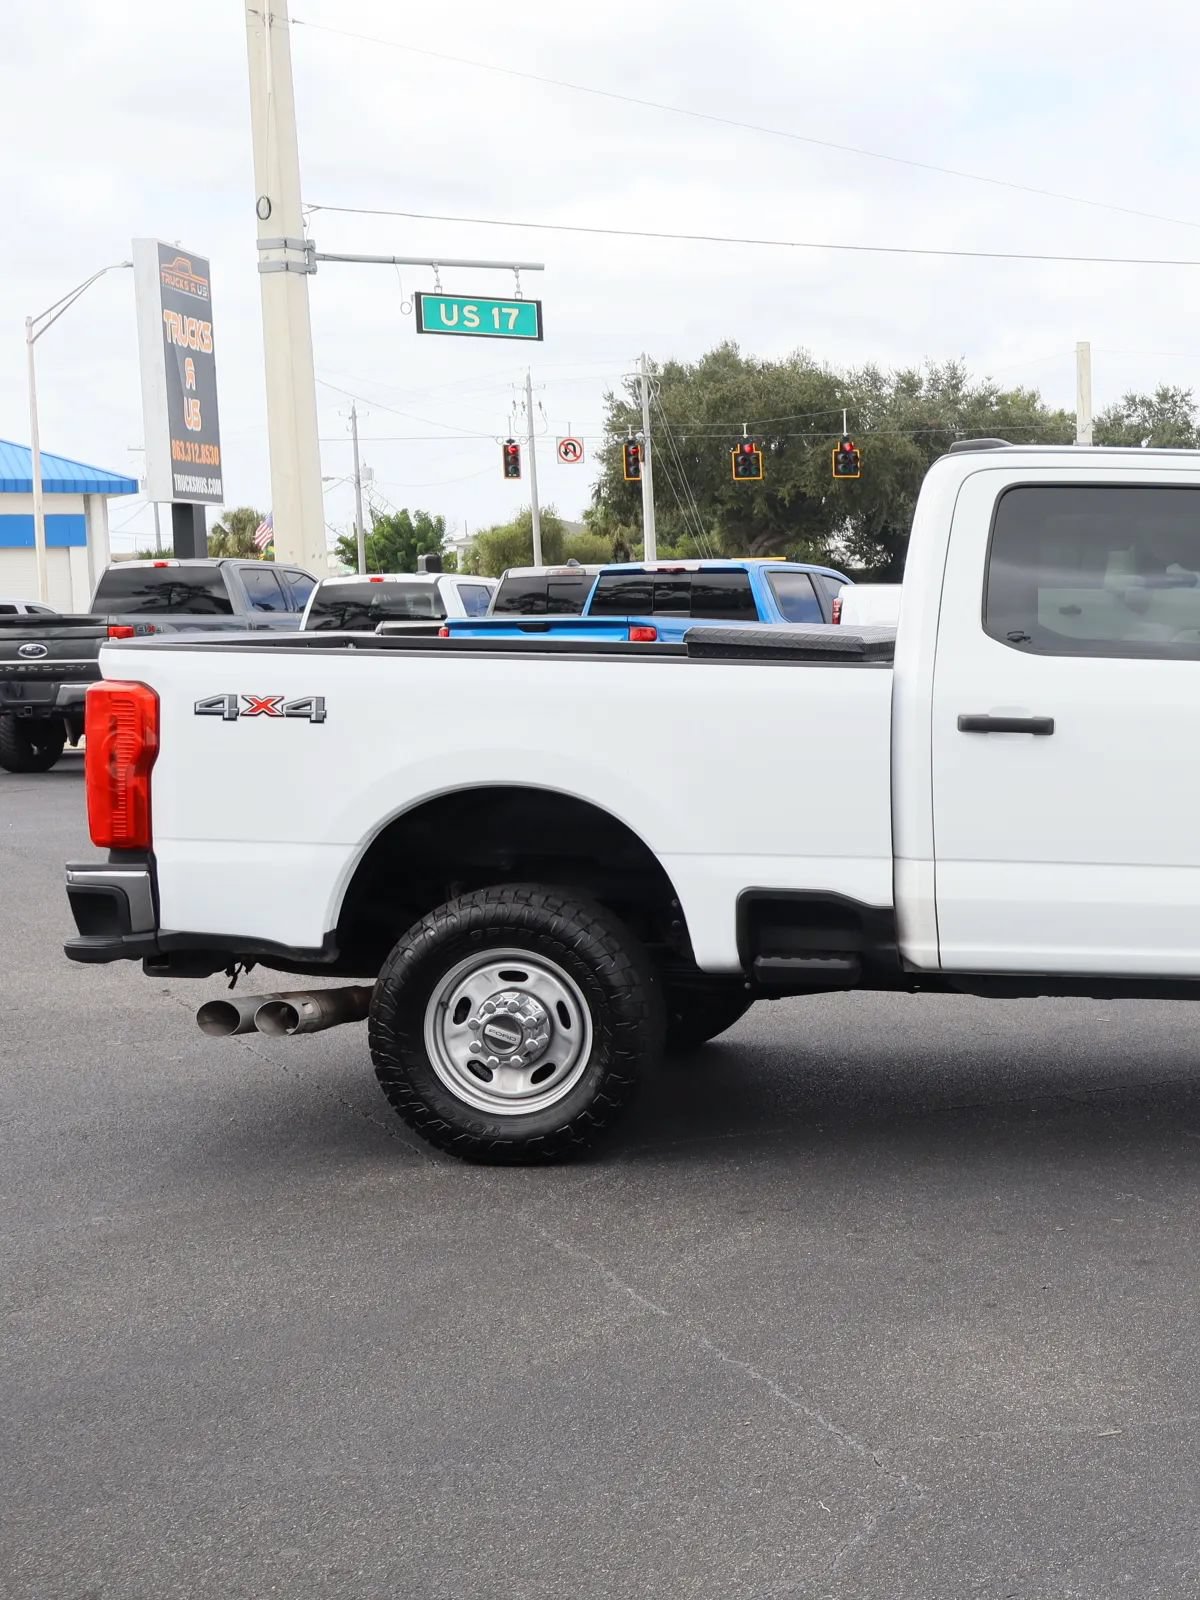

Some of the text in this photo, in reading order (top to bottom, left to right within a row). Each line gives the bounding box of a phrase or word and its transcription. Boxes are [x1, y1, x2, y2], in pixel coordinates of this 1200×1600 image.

[160, 271, 189, 290] TRUCKS
[197, 284, 208, 297] US
[440, 303, 520, 330] US 17
[163, 309, 213, 354] TRUCKS
[184, 397, 202, 431] US
[488, 1028, 517, 1042] FORD
